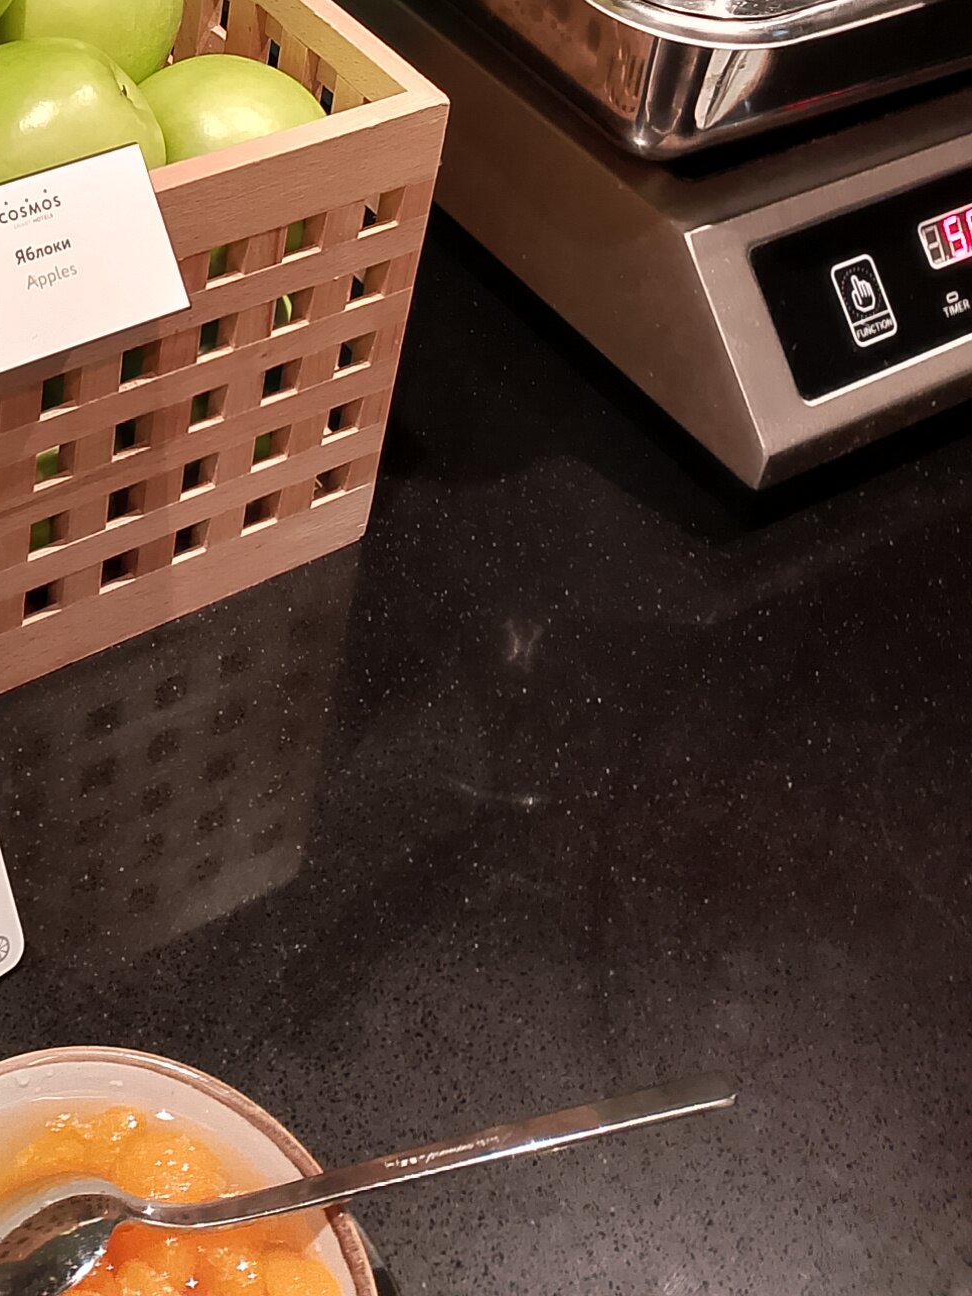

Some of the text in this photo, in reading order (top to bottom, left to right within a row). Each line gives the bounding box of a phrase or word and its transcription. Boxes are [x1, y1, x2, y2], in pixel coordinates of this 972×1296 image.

[15, 238, 71, 265] Яблоки
[27, 264, 78, 290] Apples
[942, 298, 971, 318] TIMER
[856, 318, 893, 339] FUNCTION
